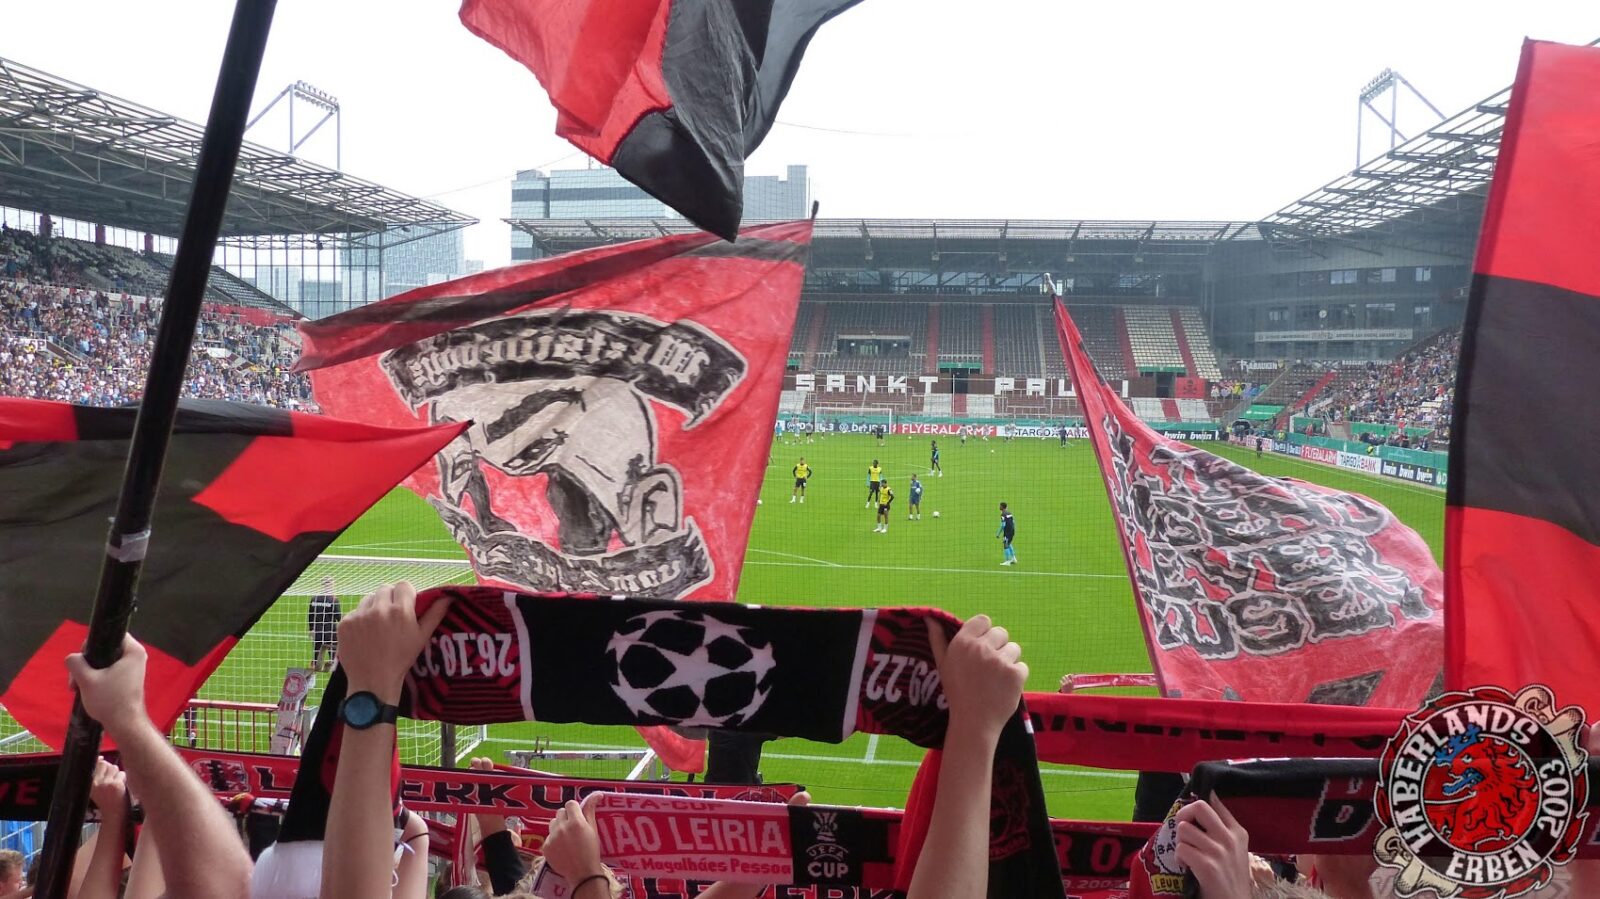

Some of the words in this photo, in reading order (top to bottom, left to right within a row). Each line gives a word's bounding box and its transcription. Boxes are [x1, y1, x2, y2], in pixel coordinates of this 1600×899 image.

[796, 374, 938, 394] SANKT
[995, 377, 1129, 398] PAUI
[1383, 461, 1397, 475] bwin
[1400, 464, 1414, 479] bwin
[668, 816, 787, 855] LEIRIA
[731, 857, 791, 875] Pessoa
[807, 861, 849, 878] CUP
